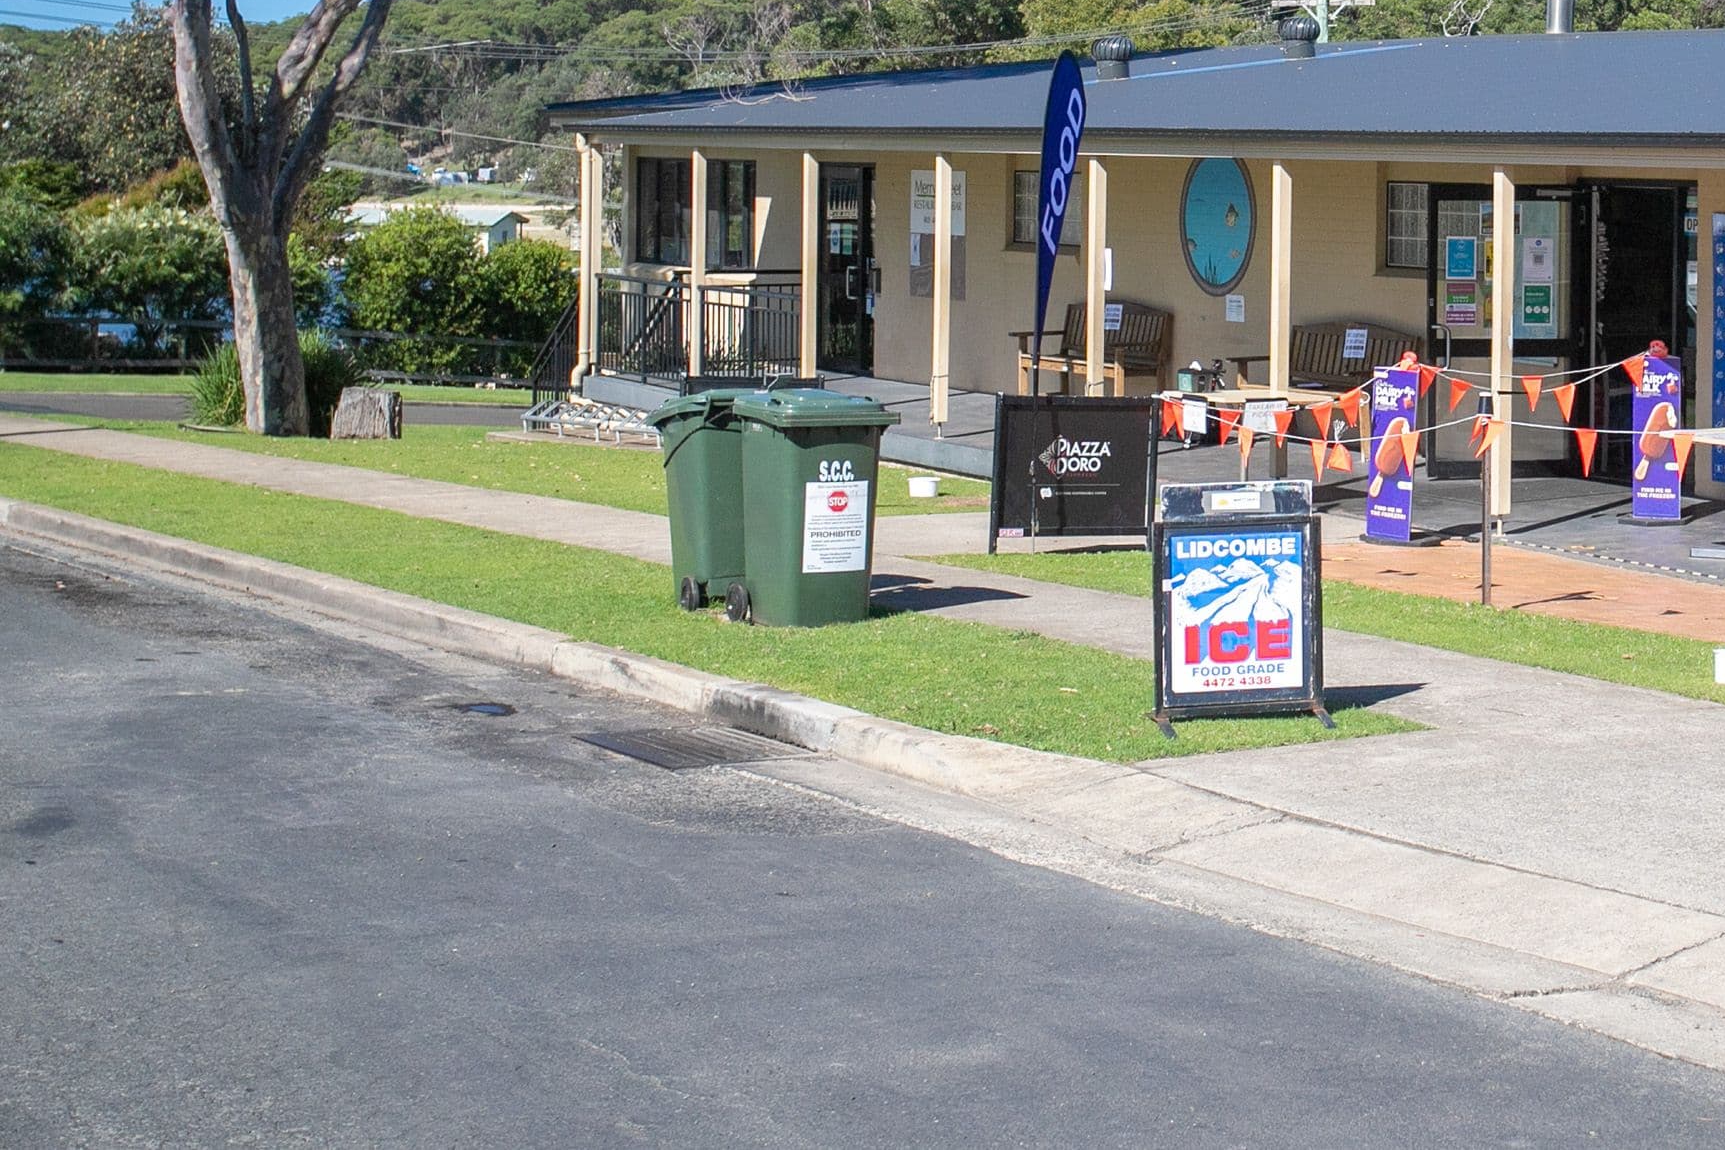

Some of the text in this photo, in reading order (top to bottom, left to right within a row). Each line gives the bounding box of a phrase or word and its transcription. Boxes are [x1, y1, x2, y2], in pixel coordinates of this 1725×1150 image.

[1041, 88, 1083, 255] FOOD
[1643, 374, 1666, 384] AIRY
[1376, 386, 1403, 397] DAIRY
[1375, 394, 1398, 407] MILK
[1057, 438, 1111, 457] PIAZZA
[828, 496, 849, 507] STOP
[810, 530, 862, 538] PROHIBITED
[1176, 537, 1297, 560] LIDCOMBE
[1184, 618, 1293, 666] ICE
[1192, 663, 1286, 677] FOOD GRADE
[1202, 676, 1272, 688] 4472 4338
